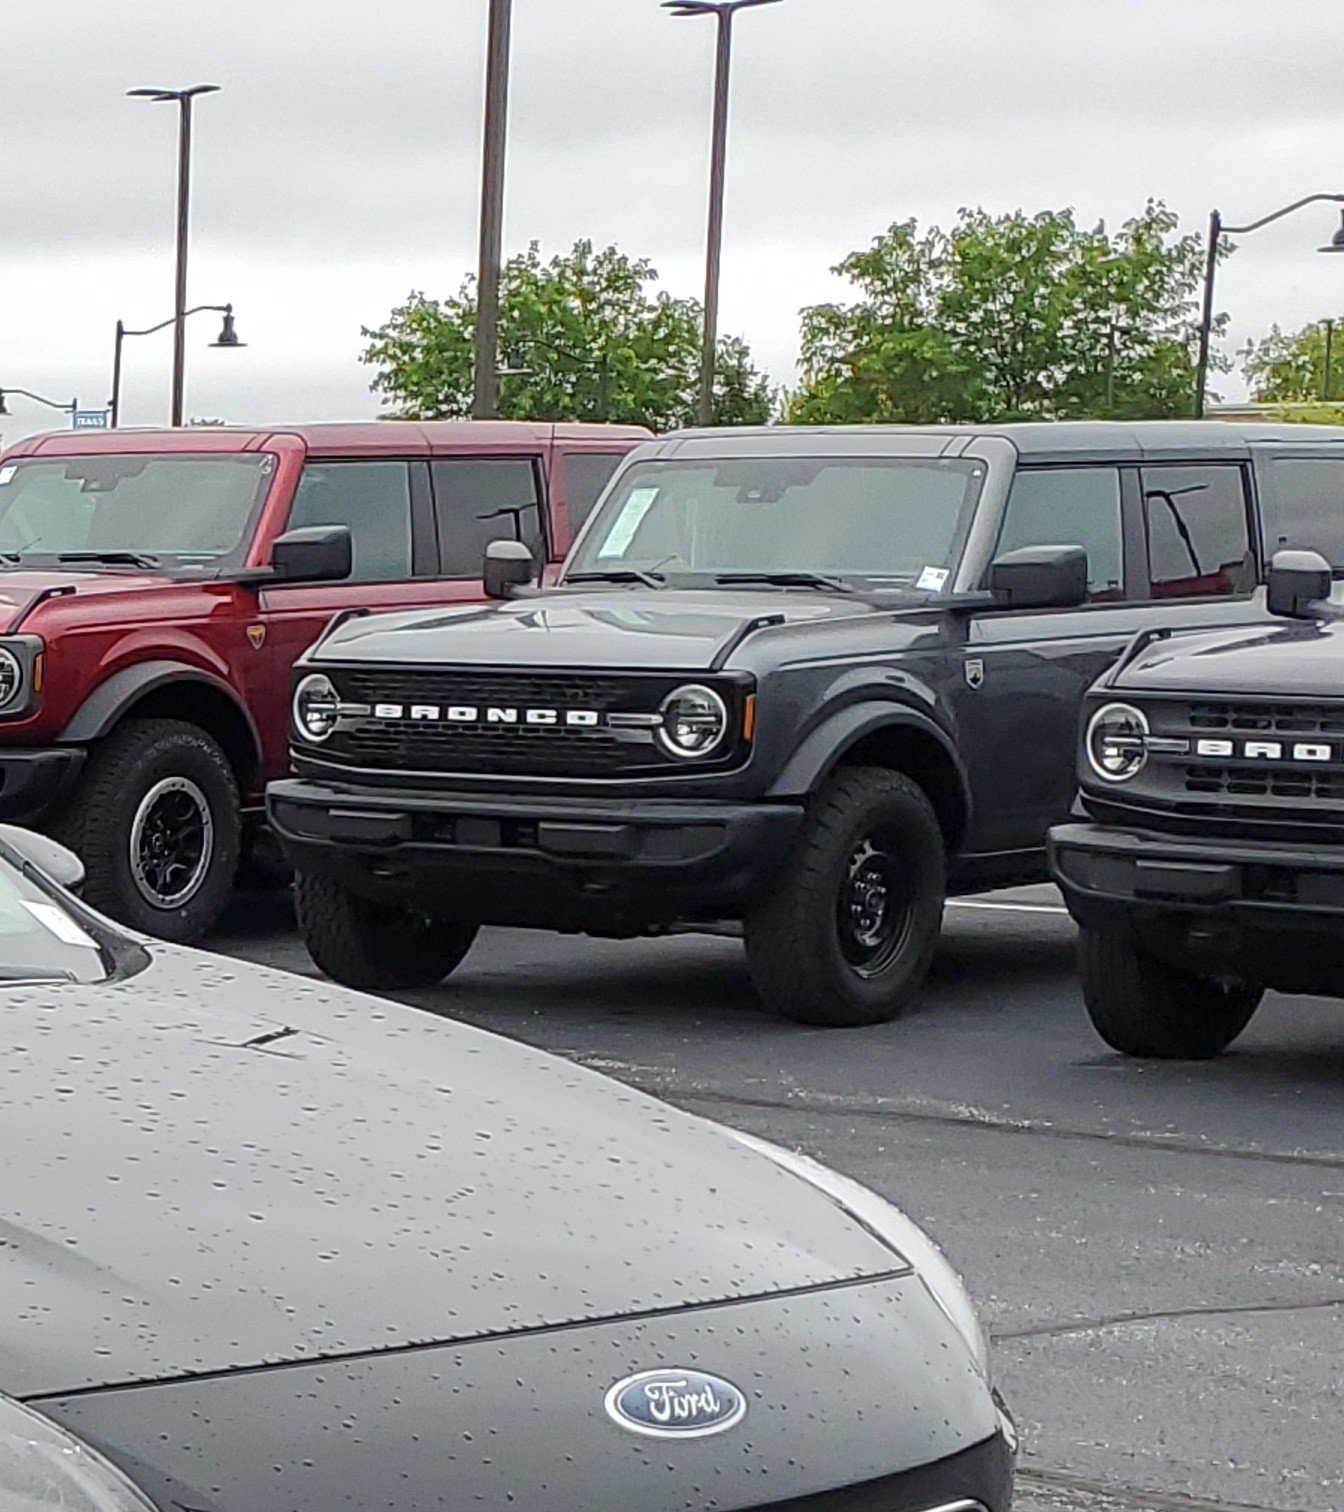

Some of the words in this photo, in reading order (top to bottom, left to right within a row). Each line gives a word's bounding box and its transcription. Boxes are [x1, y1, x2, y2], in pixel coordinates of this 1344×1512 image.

[375, 703, 598, 725] BRONCO
[1197, 739, 1331, 761] BRO
[644, 1379, 721, 1421] Ford
